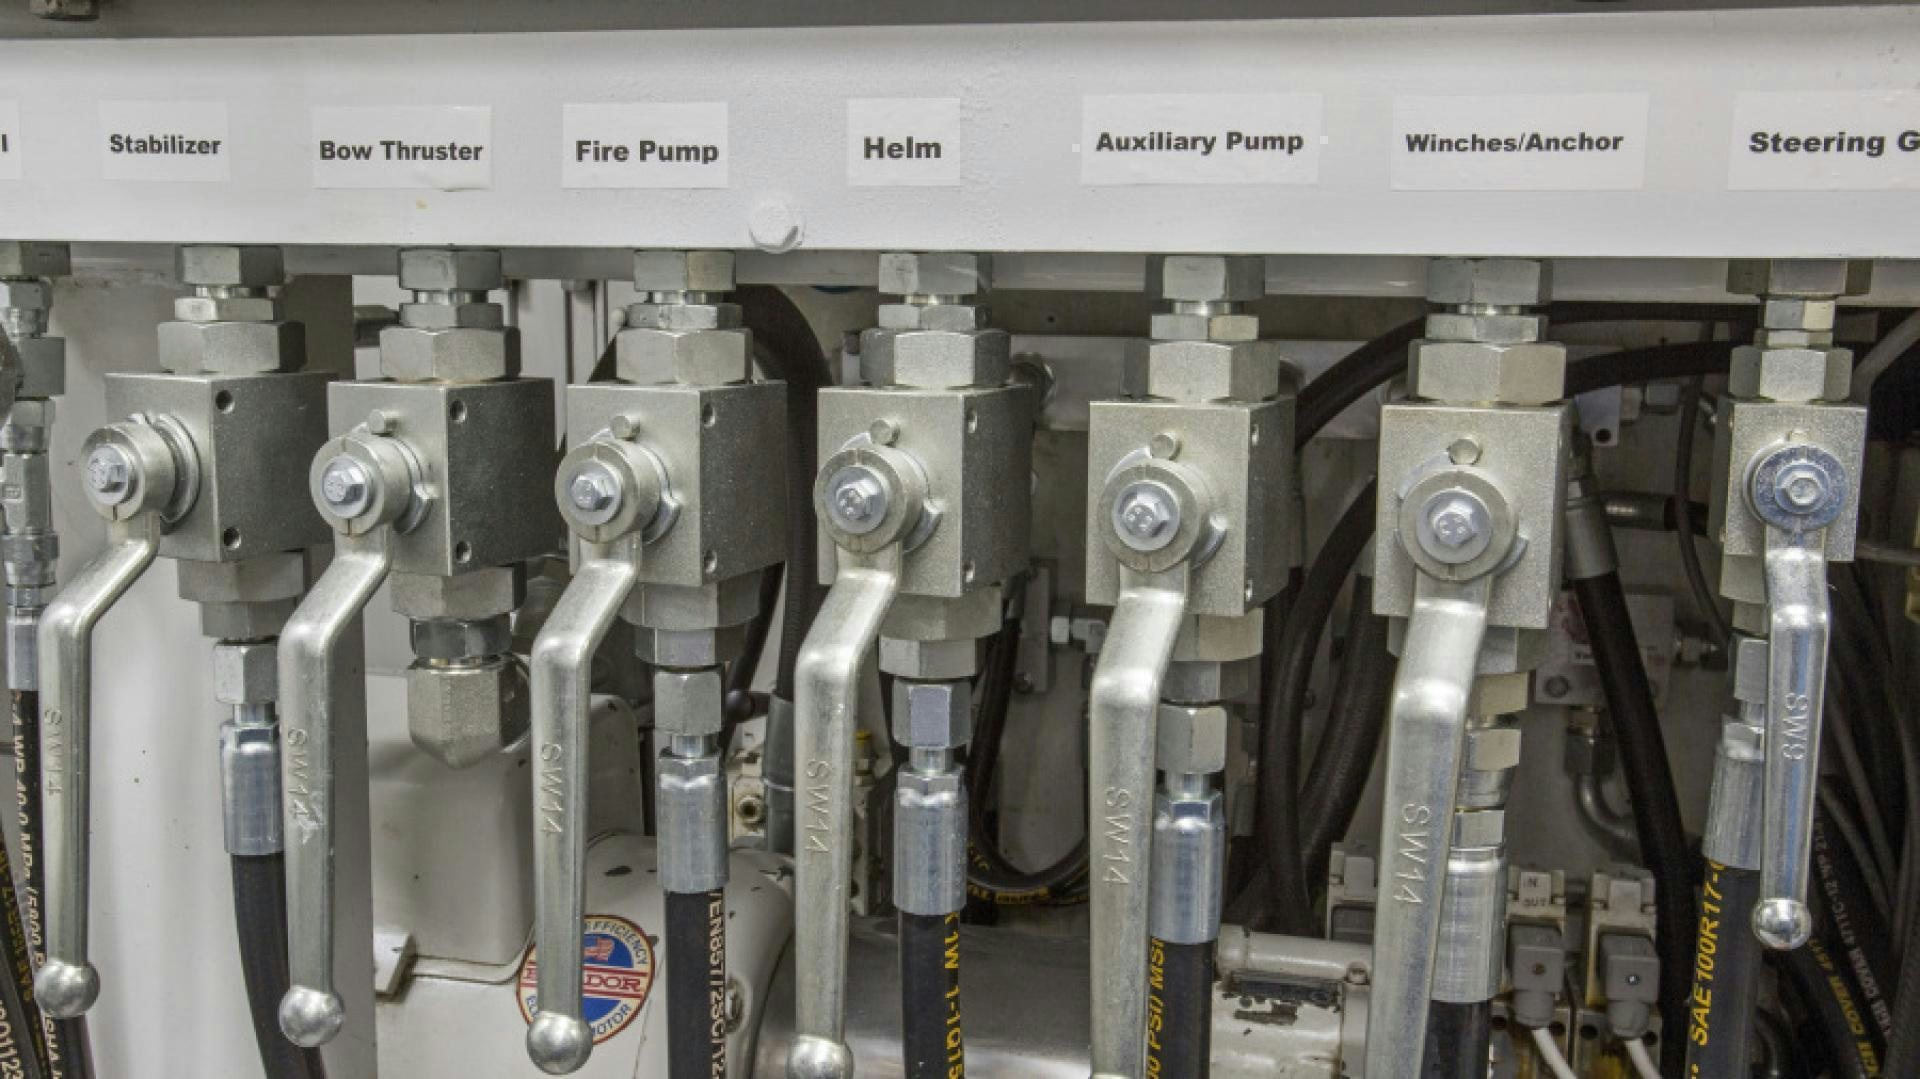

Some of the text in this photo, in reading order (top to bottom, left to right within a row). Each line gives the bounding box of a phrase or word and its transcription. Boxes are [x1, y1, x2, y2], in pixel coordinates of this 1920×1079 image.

[110, 133, 222, 155] Stabilizer
[319, 140, 484, 161] Bow Thruster
[575, 140, 720, 165] Fire Pump
[863, 136, 942, 159] Helm
[1095, 131, 1304, 156] Auxiliary Pump
[1405, 131, 1625, 153] Winches/Anchor
[1748, 131, 1885, 159] Steering
[287, 727, 309, 819] SW14
[541, 742, 563, 836] SW14
[804, 758, 833, 854] SW14
[1102, 786, 1131, 886] SW14
[1393, 802, 1432, 905] SW14
